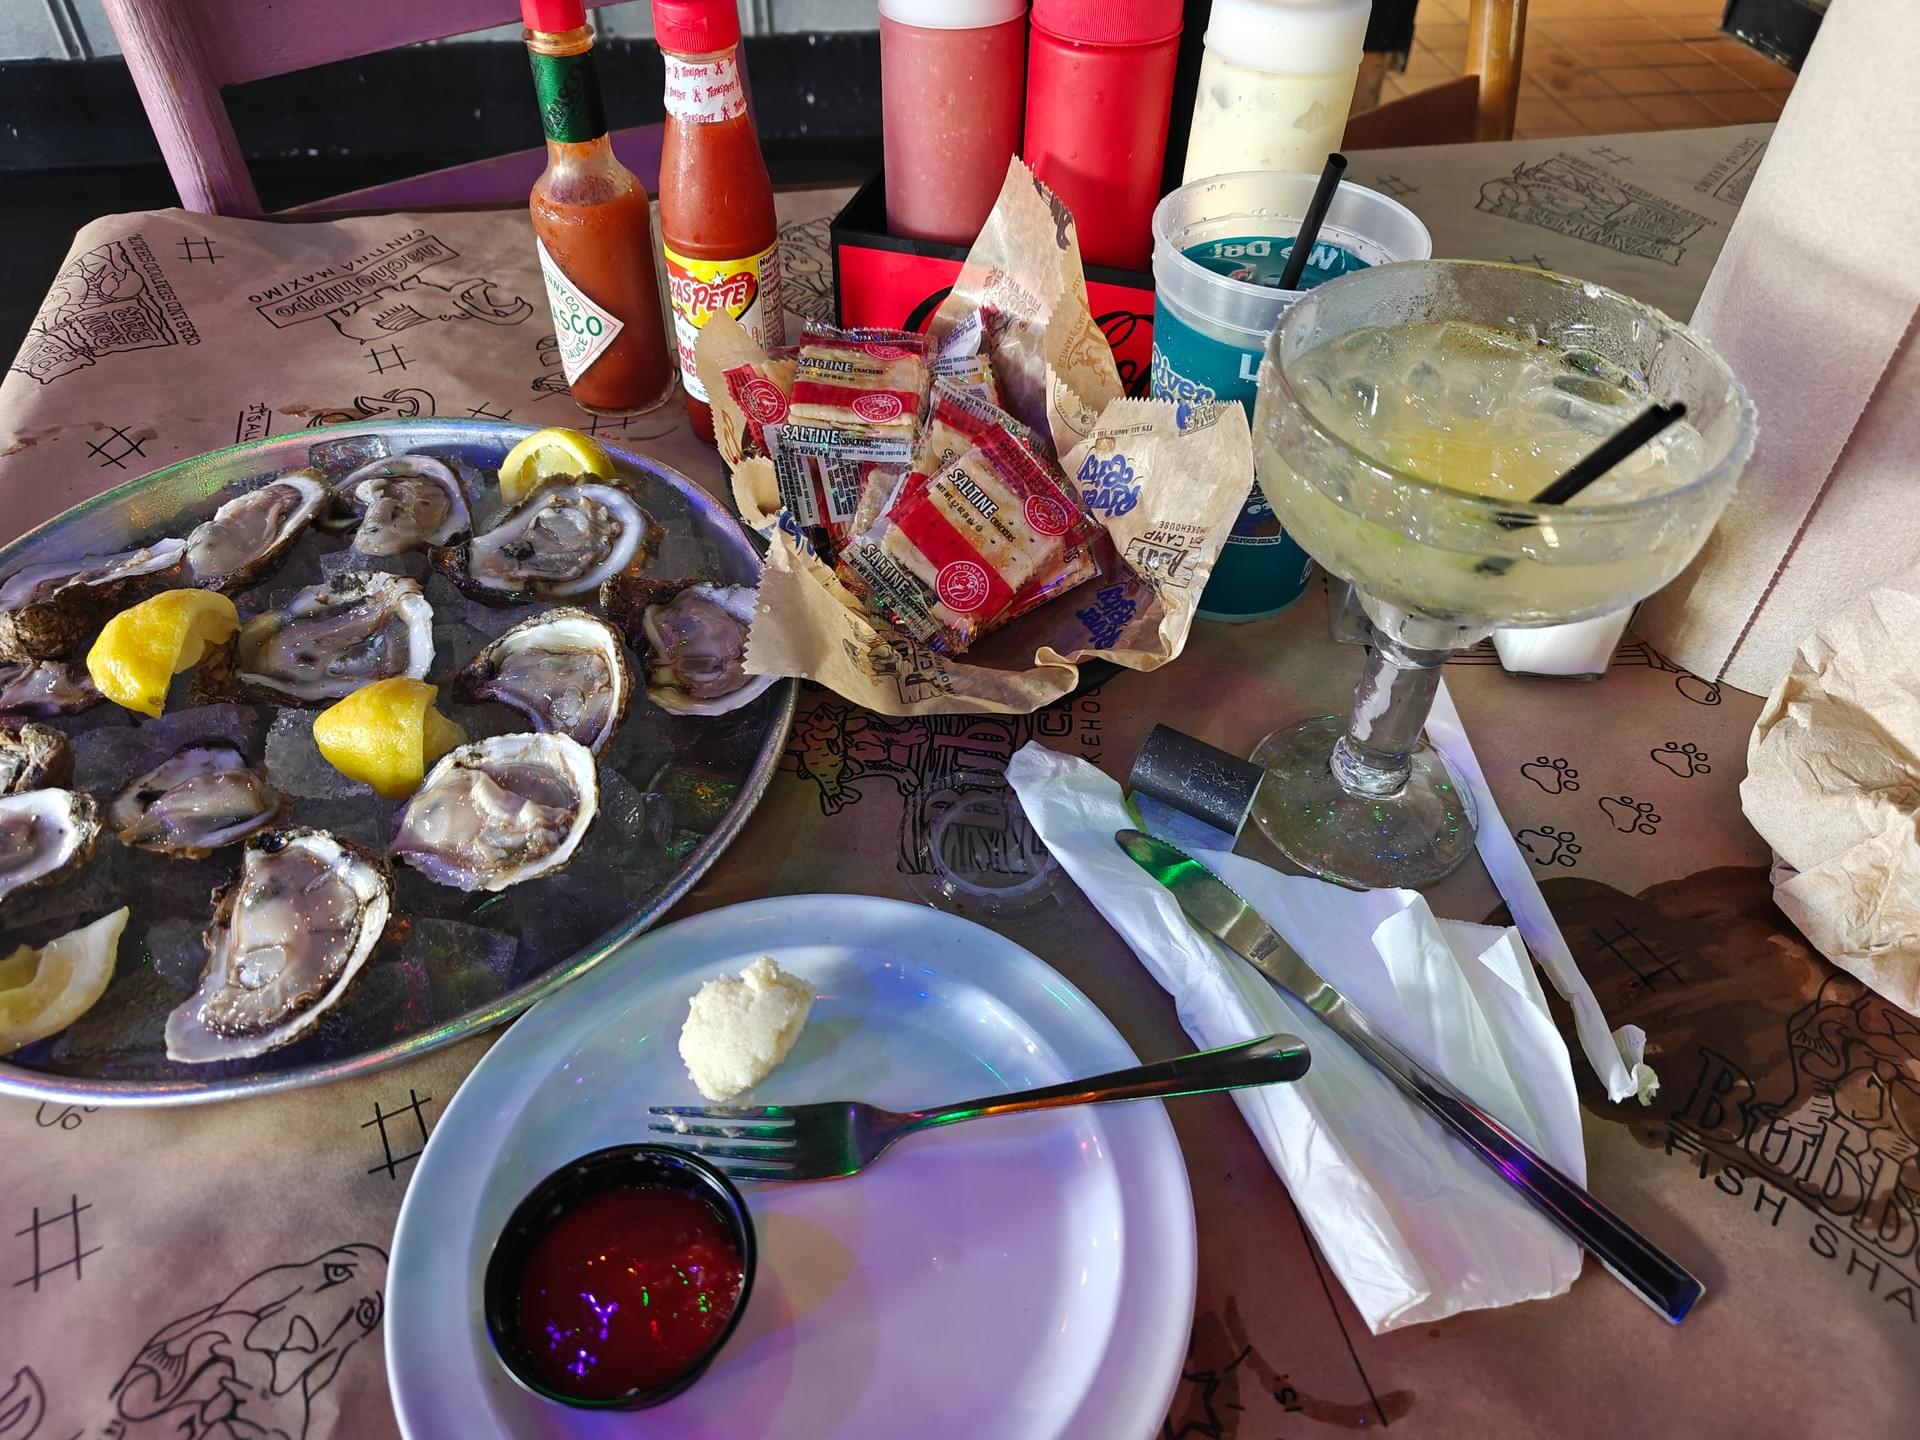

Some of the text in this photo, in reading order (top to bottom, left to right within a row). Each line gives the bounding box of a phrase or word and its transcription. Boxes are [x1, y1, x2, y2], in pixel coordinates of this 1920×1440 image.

[248, 228, 425, 303] CANTINA MAXIMO
[691, 281, 747, 316] PETE
[566, 337, 588, 360] SAUCE
[800, 357, 853, 373] SALTINE
[782, 424, 841, 446] SALTINE
[949, 469, 999, 519] SALTINE
[990, 517, 1016, 542] CRACKERS
[1144, 531, 1184, 547] CAMP
[861, 543, 911, 595] SALTINE
[954, 563, 986, 597] MONARCH
[1665, 1124, 1791, 1228] FISH
